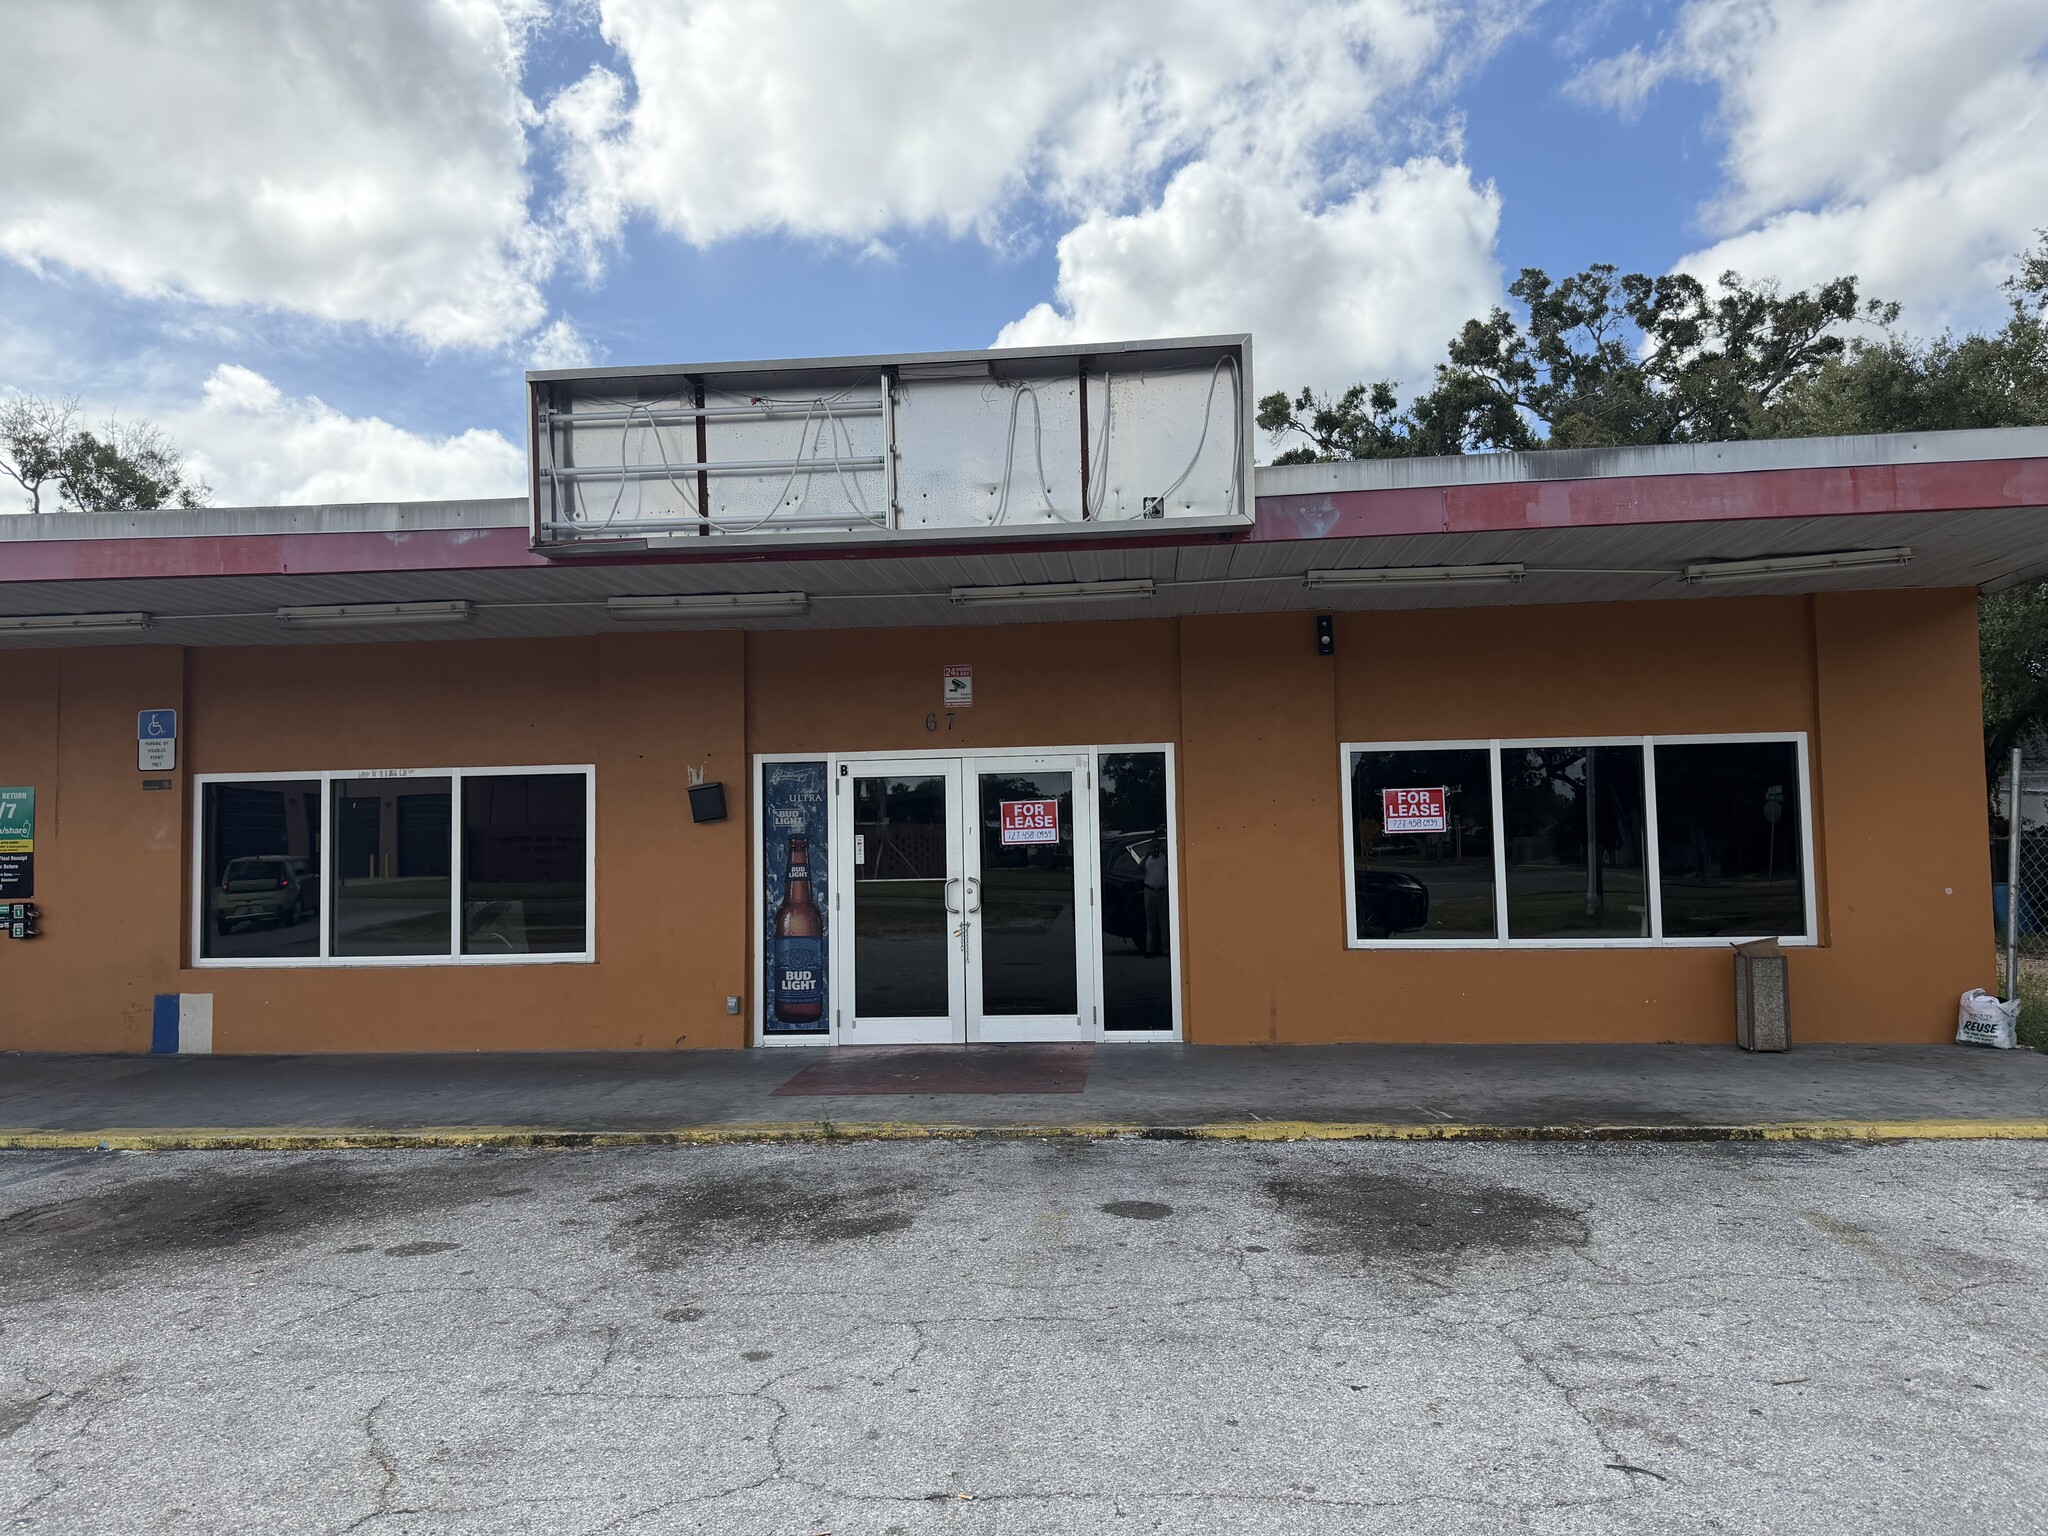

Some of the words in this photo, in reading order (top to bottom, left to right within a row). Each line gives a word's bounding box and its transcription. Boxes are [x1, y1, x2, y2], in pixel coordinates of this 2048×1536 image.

[945, 667, 956, 676] 24
[840, 765, 849, 777] B
[1, 792, 27, 800] RETURN
[789, 794, 822, 802] ULTRA
[1397, 791, 1430, 804] FOR
[778, 810, 799, 818] BUD
[1014, 803, 1044, 816] FOR
[1388, 803, 1441, 817] LEASE
[775, 817, 803, 825] LIGHT
[1005, 815, 1054, 829] LEASE
[1393, 819, 1407, 829] 727
[1408, 818, 1422, 828] 458
[1007, 831, 1020, 840] 727
[785, 970, 812, 981] BUD
[781, 980, 817, 991] LIGHT
[1963, 1020, 1999, 1034] REUSE
